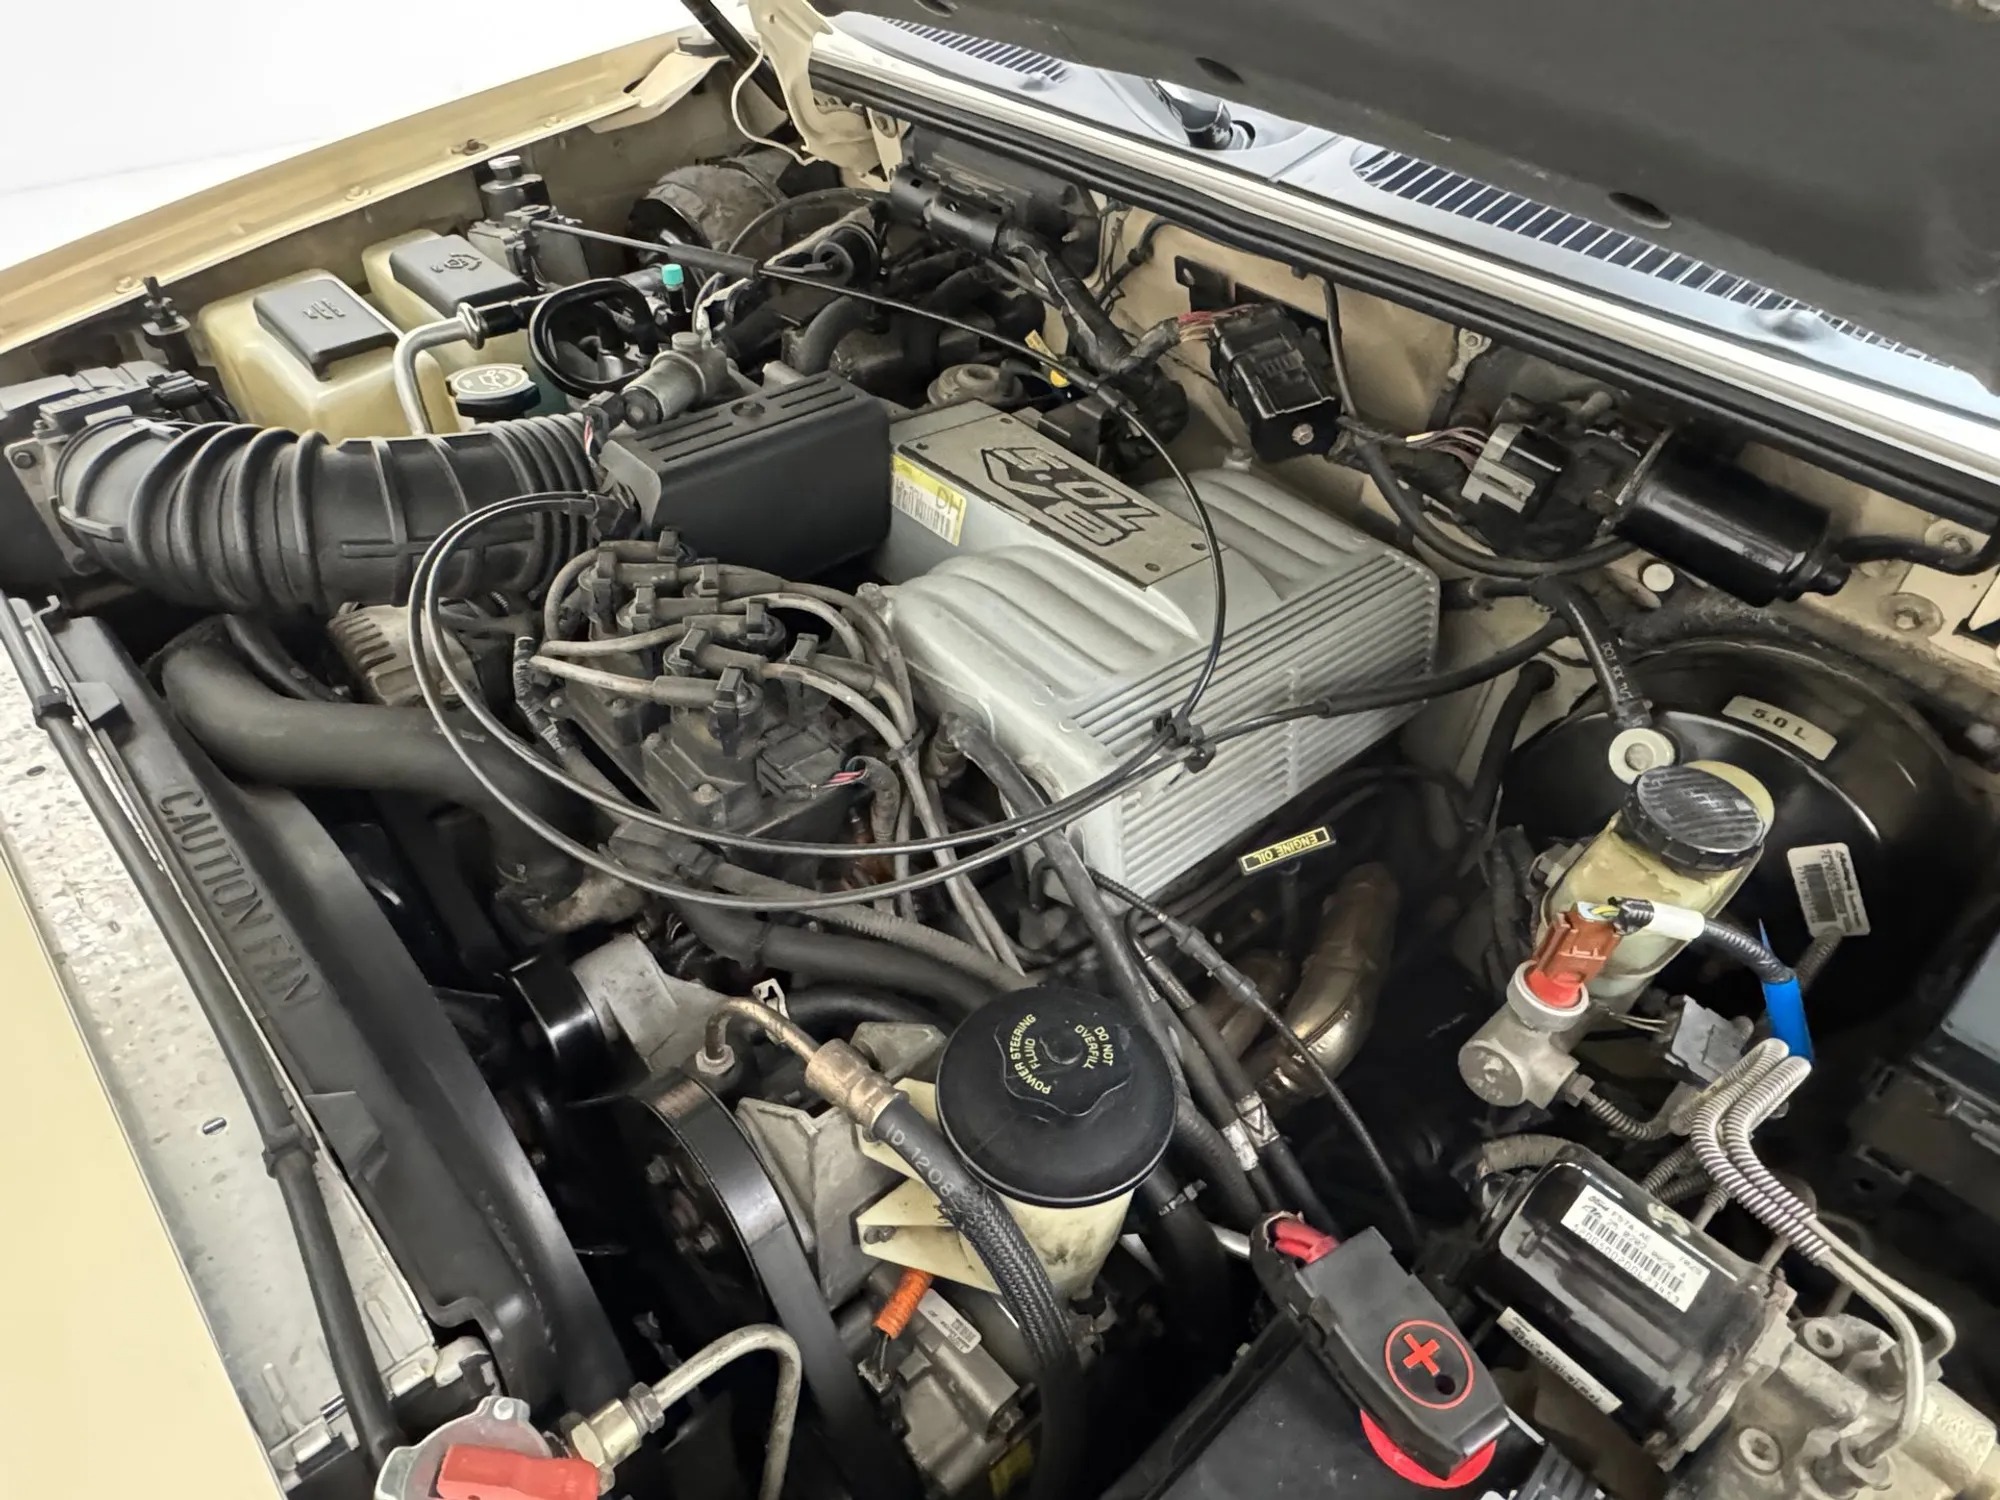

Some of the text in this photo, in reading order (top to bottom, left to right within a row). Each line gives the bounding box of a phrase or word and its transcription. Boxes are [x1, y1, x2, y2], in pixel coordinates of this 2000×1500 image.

[935, 486, 963, 521] DH
[982, 452, 1125, 545] V8
[987, 447, 1159, 531] 5.0L
[1752, 708, 1807, 741] 5.0 L
[1253, 832, 1318, 864] ENGINE OIL
[159, 791, 322, 1010] CAUTION FAN
[1009, 1013, 1052, 1095] POWER STEERING
[1024, 1038, 1041, 1070] FLUID
[1074, 1024, 1100, 1070] OVERFILL
[1094, 1025, 1114, 1067] DO NOT
[911, 1147, 956, 1196] 1208
